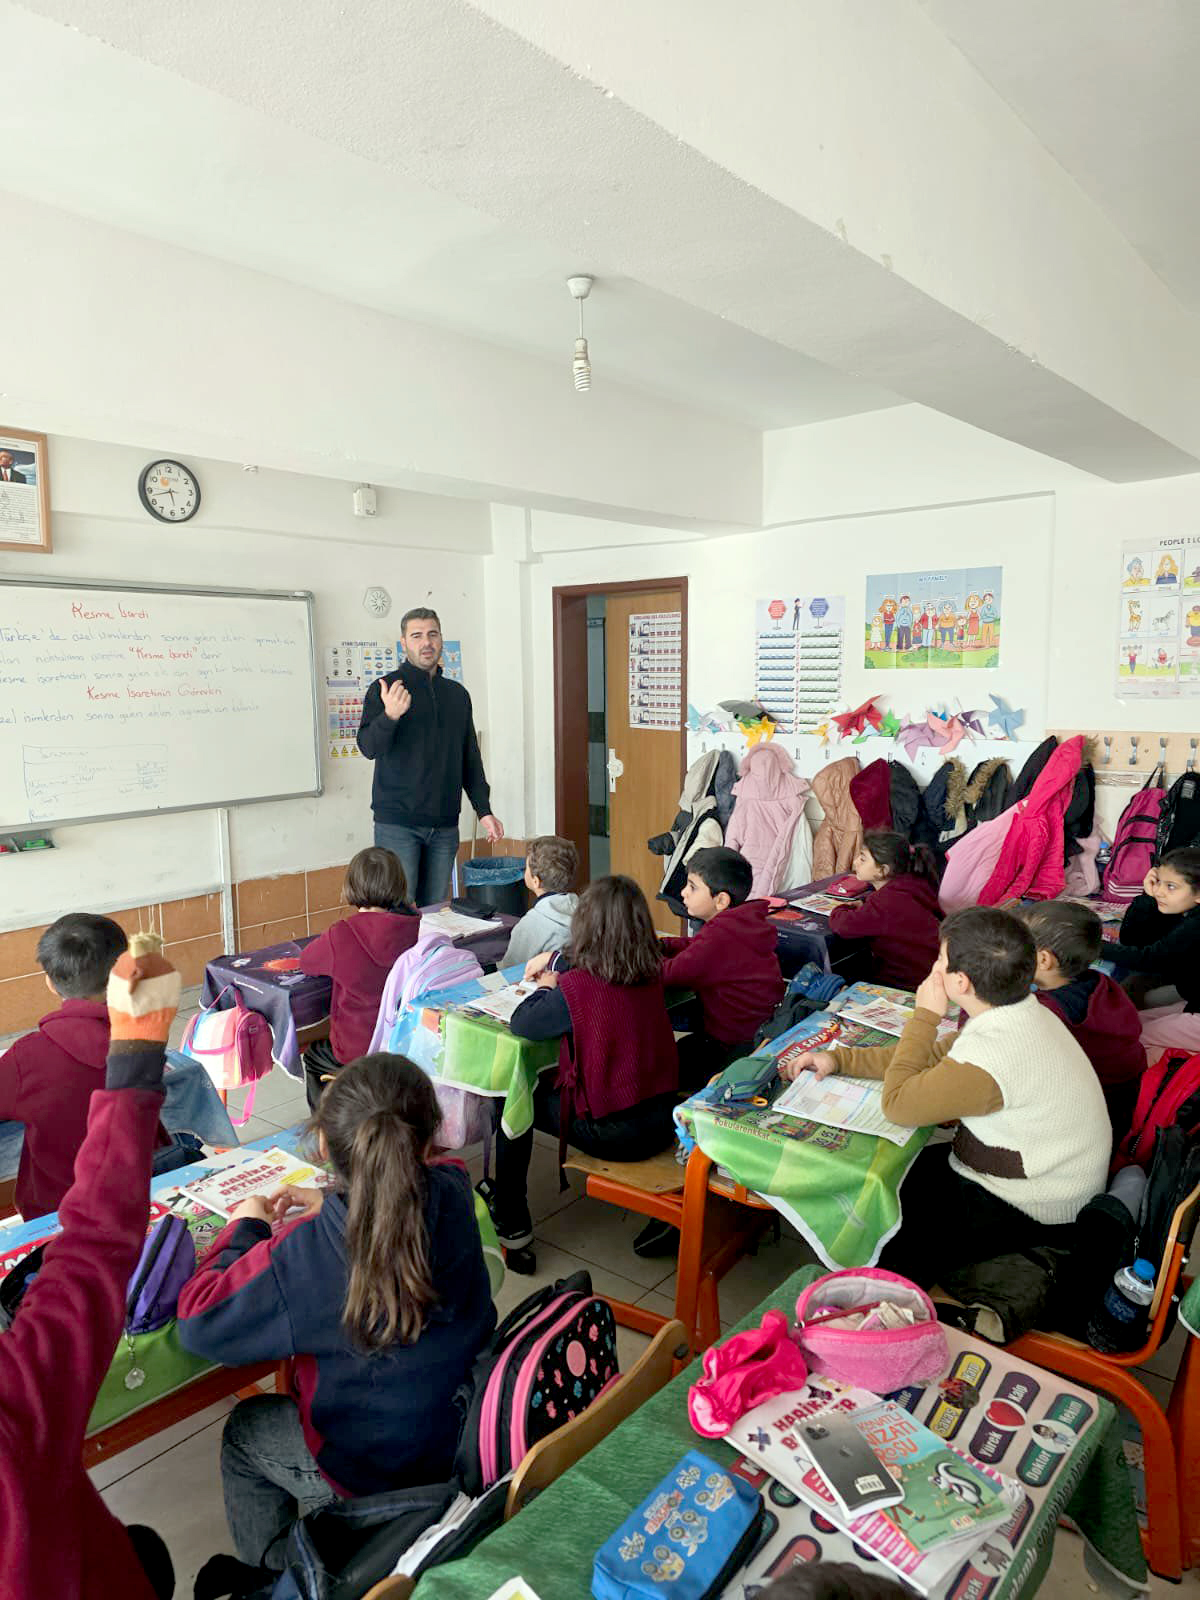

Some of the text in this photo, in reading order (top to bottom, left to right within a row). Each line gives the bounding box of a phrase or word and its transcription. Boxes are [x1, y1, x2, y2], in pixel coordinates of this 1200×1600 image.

[147, 486, 153, 495] 9
[189, 489, 193, 497] 3
[159, 506, 164, 514] 7
[180, 507, 186, 515] 5
[1159, 538, 1185, 546] PEOPLE
[71, 602, 115, 619] Kesme
[86, 685, 121, 700] Kesme
[1008, 1384, 1029, 1403] Kalp
[934, 1407, 959, 1434] Savaş
[979, 1432, 1003, 1458] Yürek
[1026, 1450, 1053, 1481] Doktor
